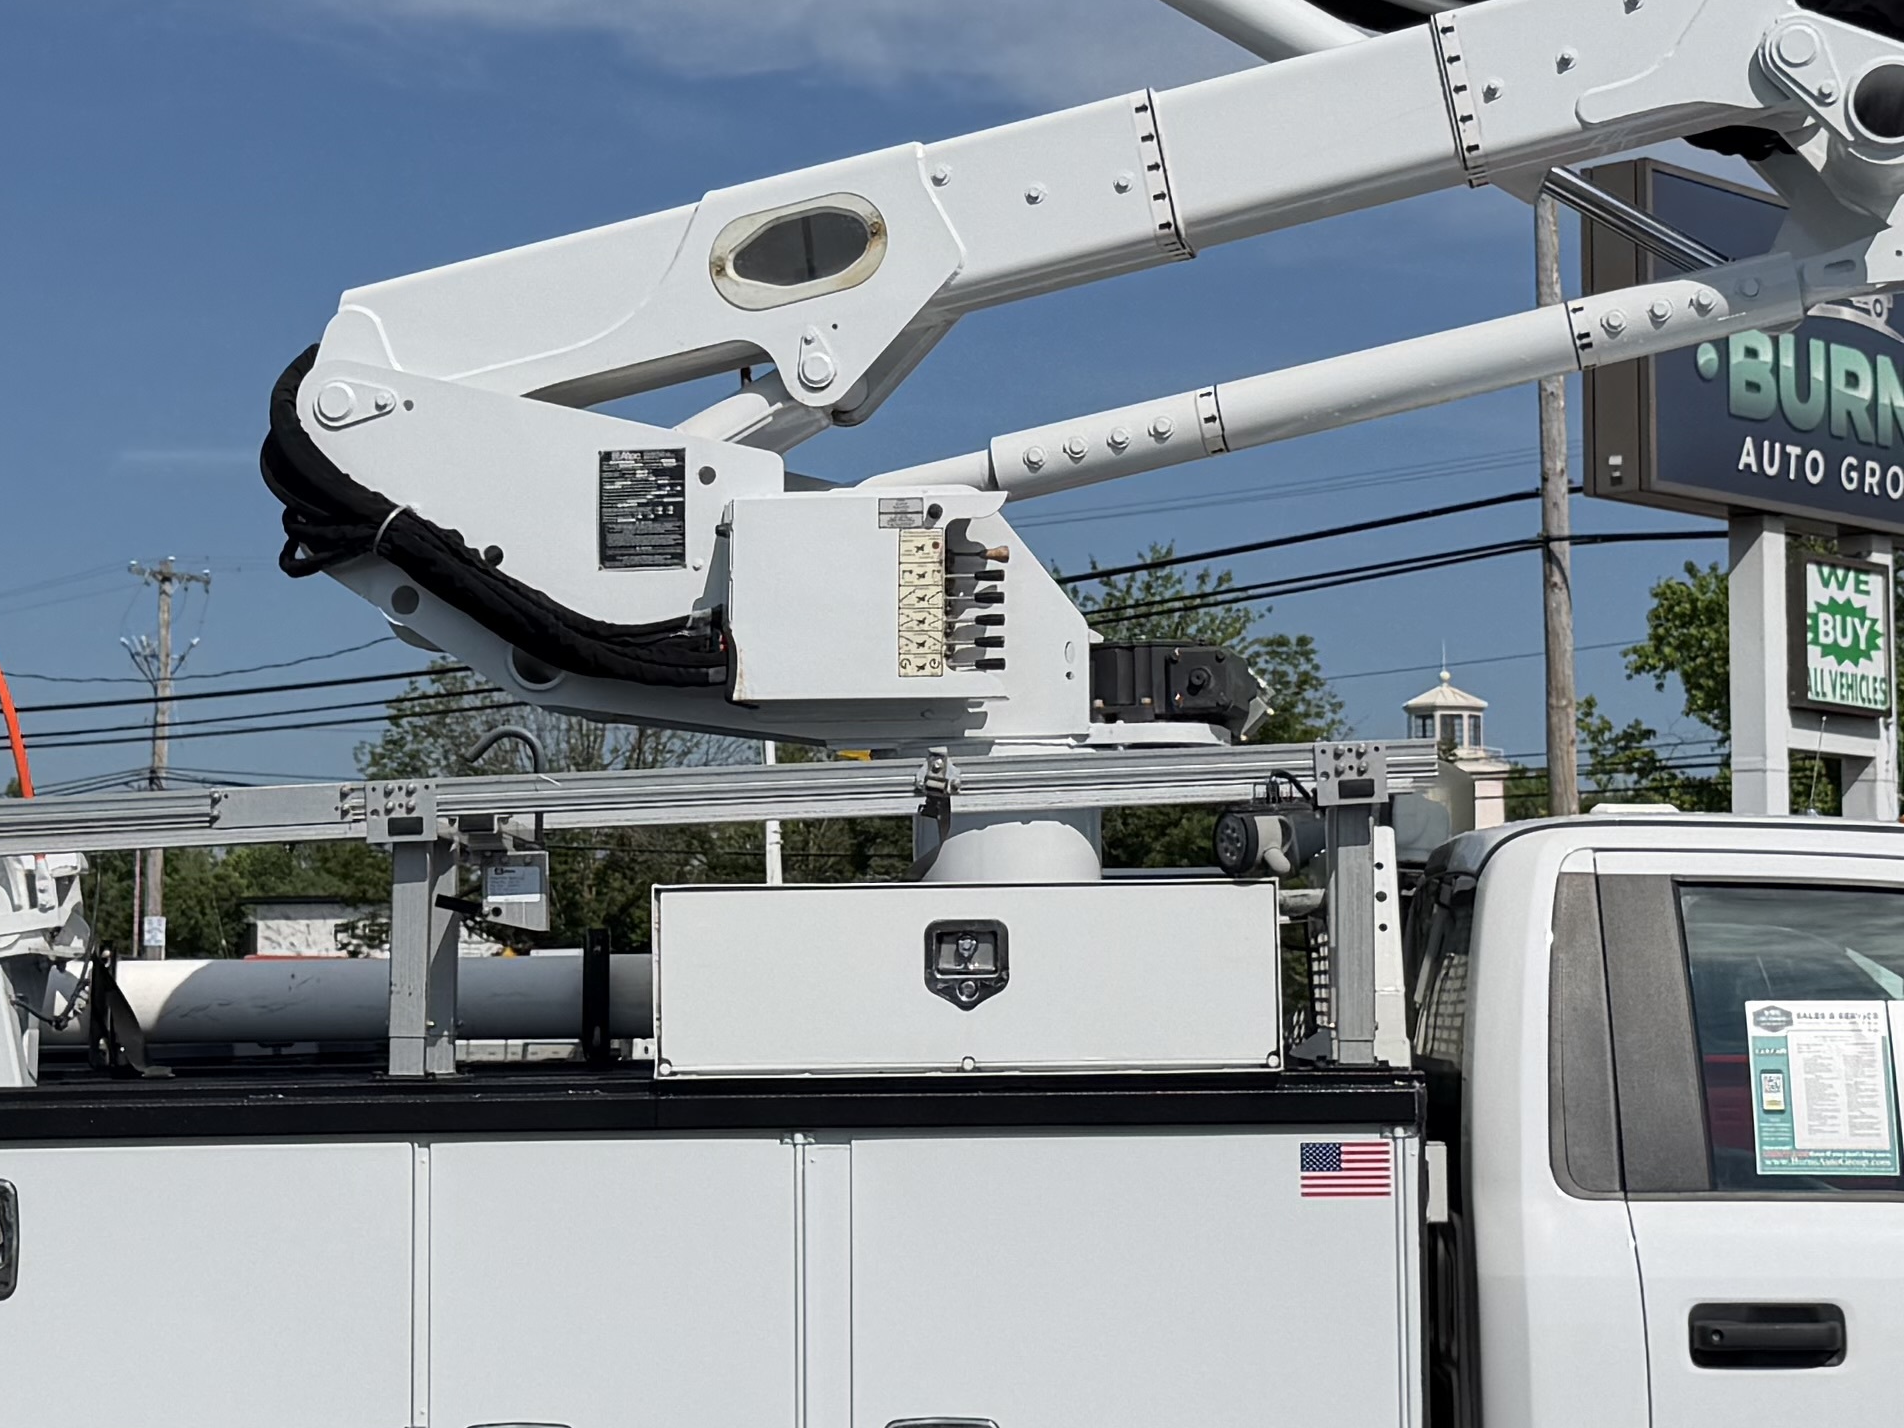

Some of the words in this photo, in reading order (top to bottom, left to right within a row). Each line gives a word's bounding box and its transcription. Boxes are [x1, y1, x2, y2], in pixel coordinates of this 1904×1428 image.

[1737, 436, 1825, 485] AUTO
[1815, 564, 1872, 596] WE
[1817, 611, 1872, 651] BUY
[1829, 668, 1888, 706] VEHICLES
